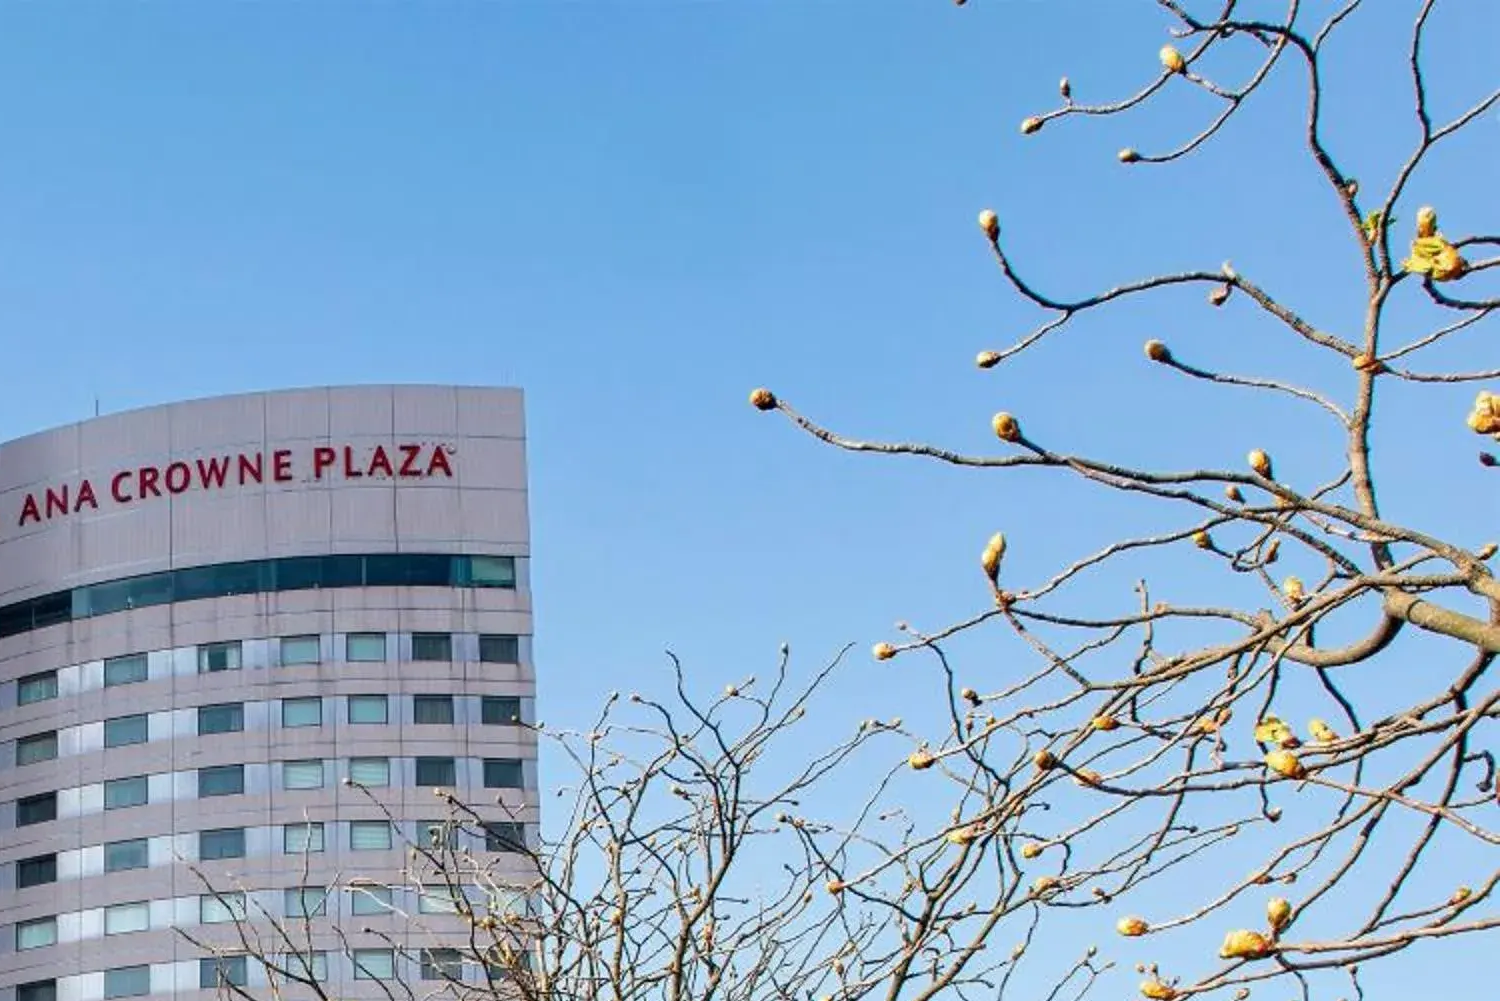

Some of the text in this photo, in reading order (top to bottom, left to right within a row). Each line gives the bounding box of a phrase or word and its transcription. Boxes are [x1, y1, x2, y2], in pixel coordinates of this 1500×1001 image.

[18, 445, 453, 527] ANA CROWNE PLAZA
